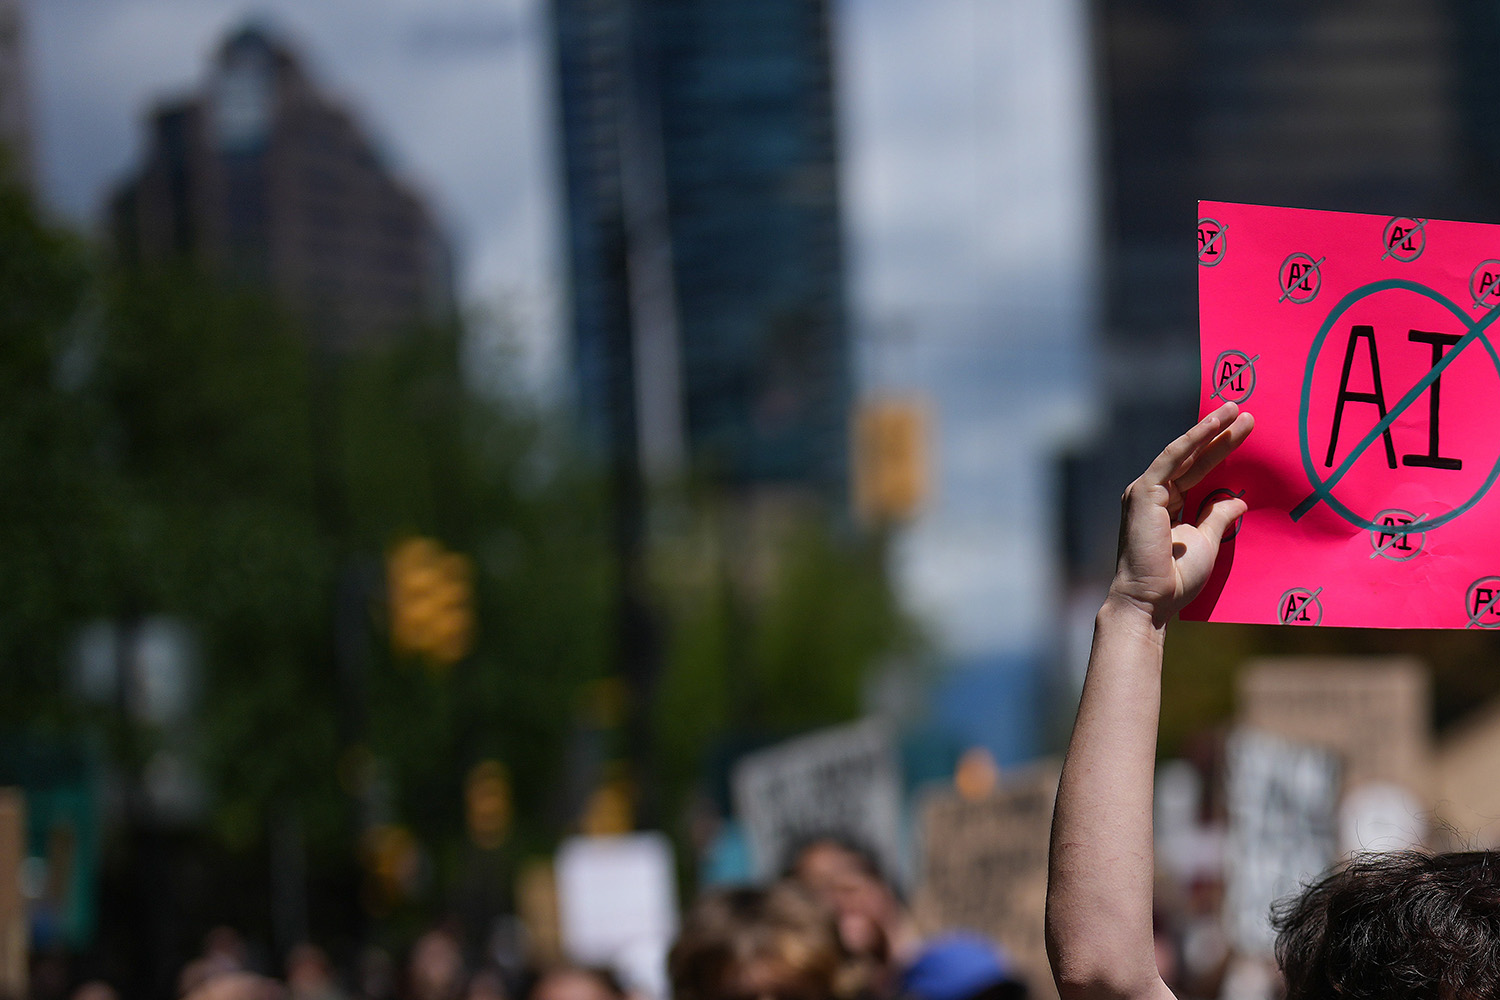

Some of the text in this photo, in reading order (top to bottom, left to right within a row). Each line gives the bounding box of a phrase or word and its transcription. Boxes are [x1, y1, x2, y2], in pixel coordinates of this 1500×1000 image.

[1389, 226, 1417, 251] AI
[1287, 263, 1312, 291] AI
[1219, 361, 1245, 392] AI
[1325, 325, 1467, 471] AI
[1378, 517, 1412, 550] AI
[1284, 594, 1311, 621] AI
